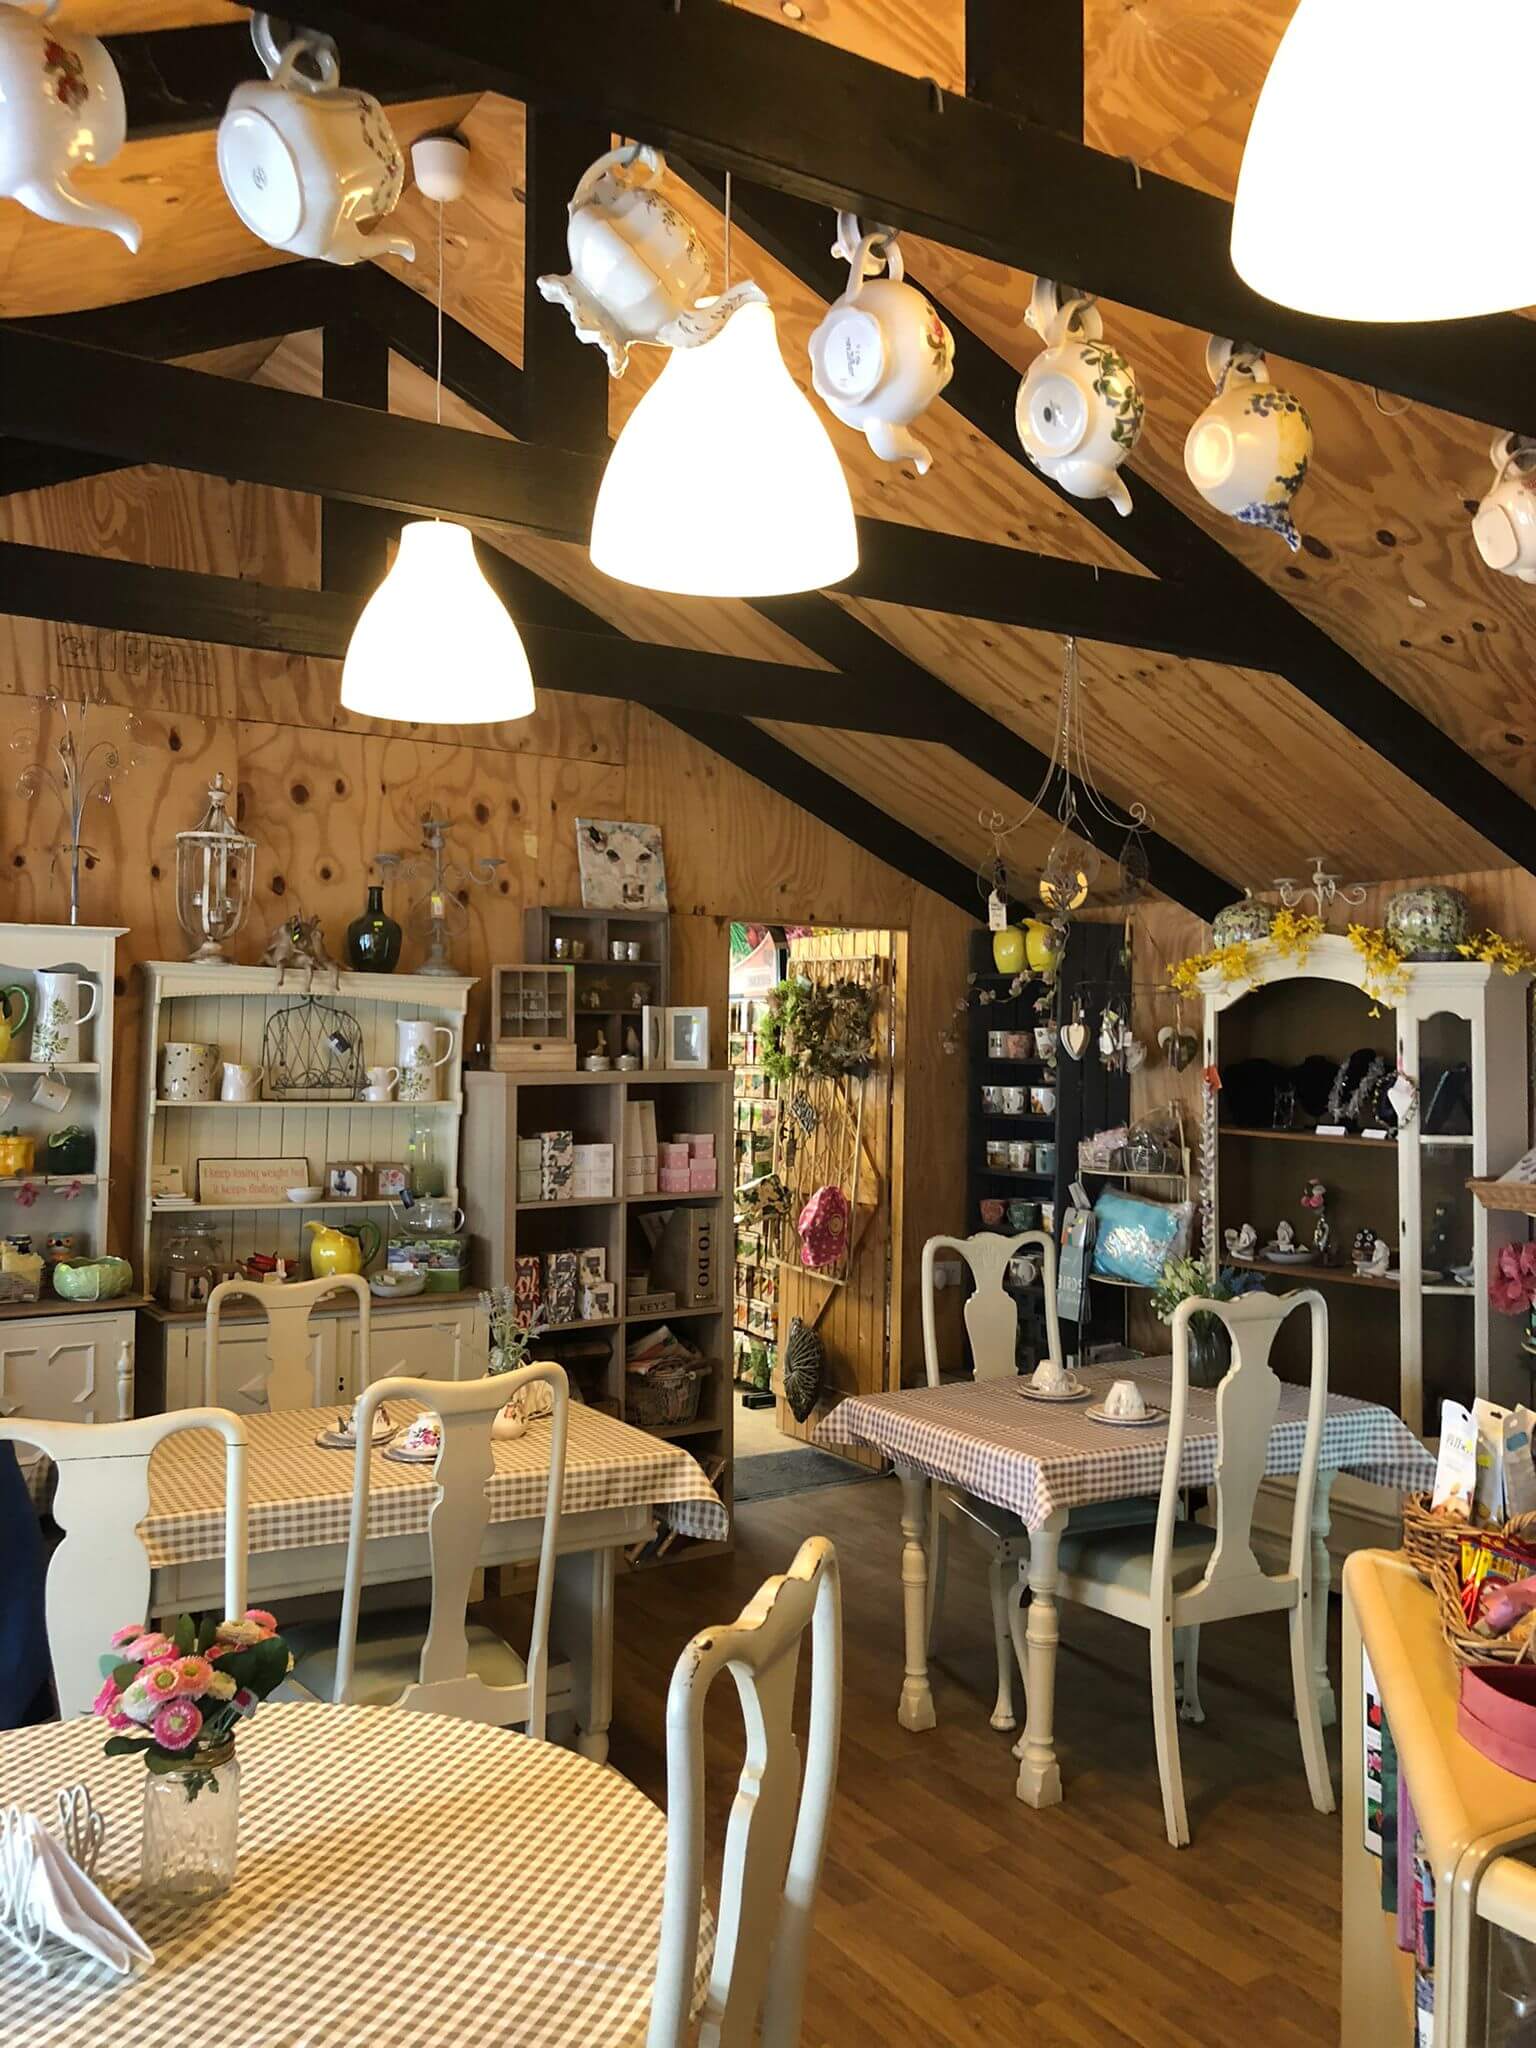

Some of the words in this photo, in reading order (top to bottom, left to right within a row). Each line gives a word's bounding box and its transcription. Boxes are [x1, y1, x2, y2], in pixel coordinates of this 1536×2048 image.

[233, 1167, 259, 1182] losing
[261, 1167, 288, 1181] weight
[221, 1183, 246, 1196] keeps
[248, 1183, 278, 1196] finding
[698, 1222, 711, 1251] TO
[698, 1258, 710, 1287] DO
[640, 1302, 667, 1313] KEYS
